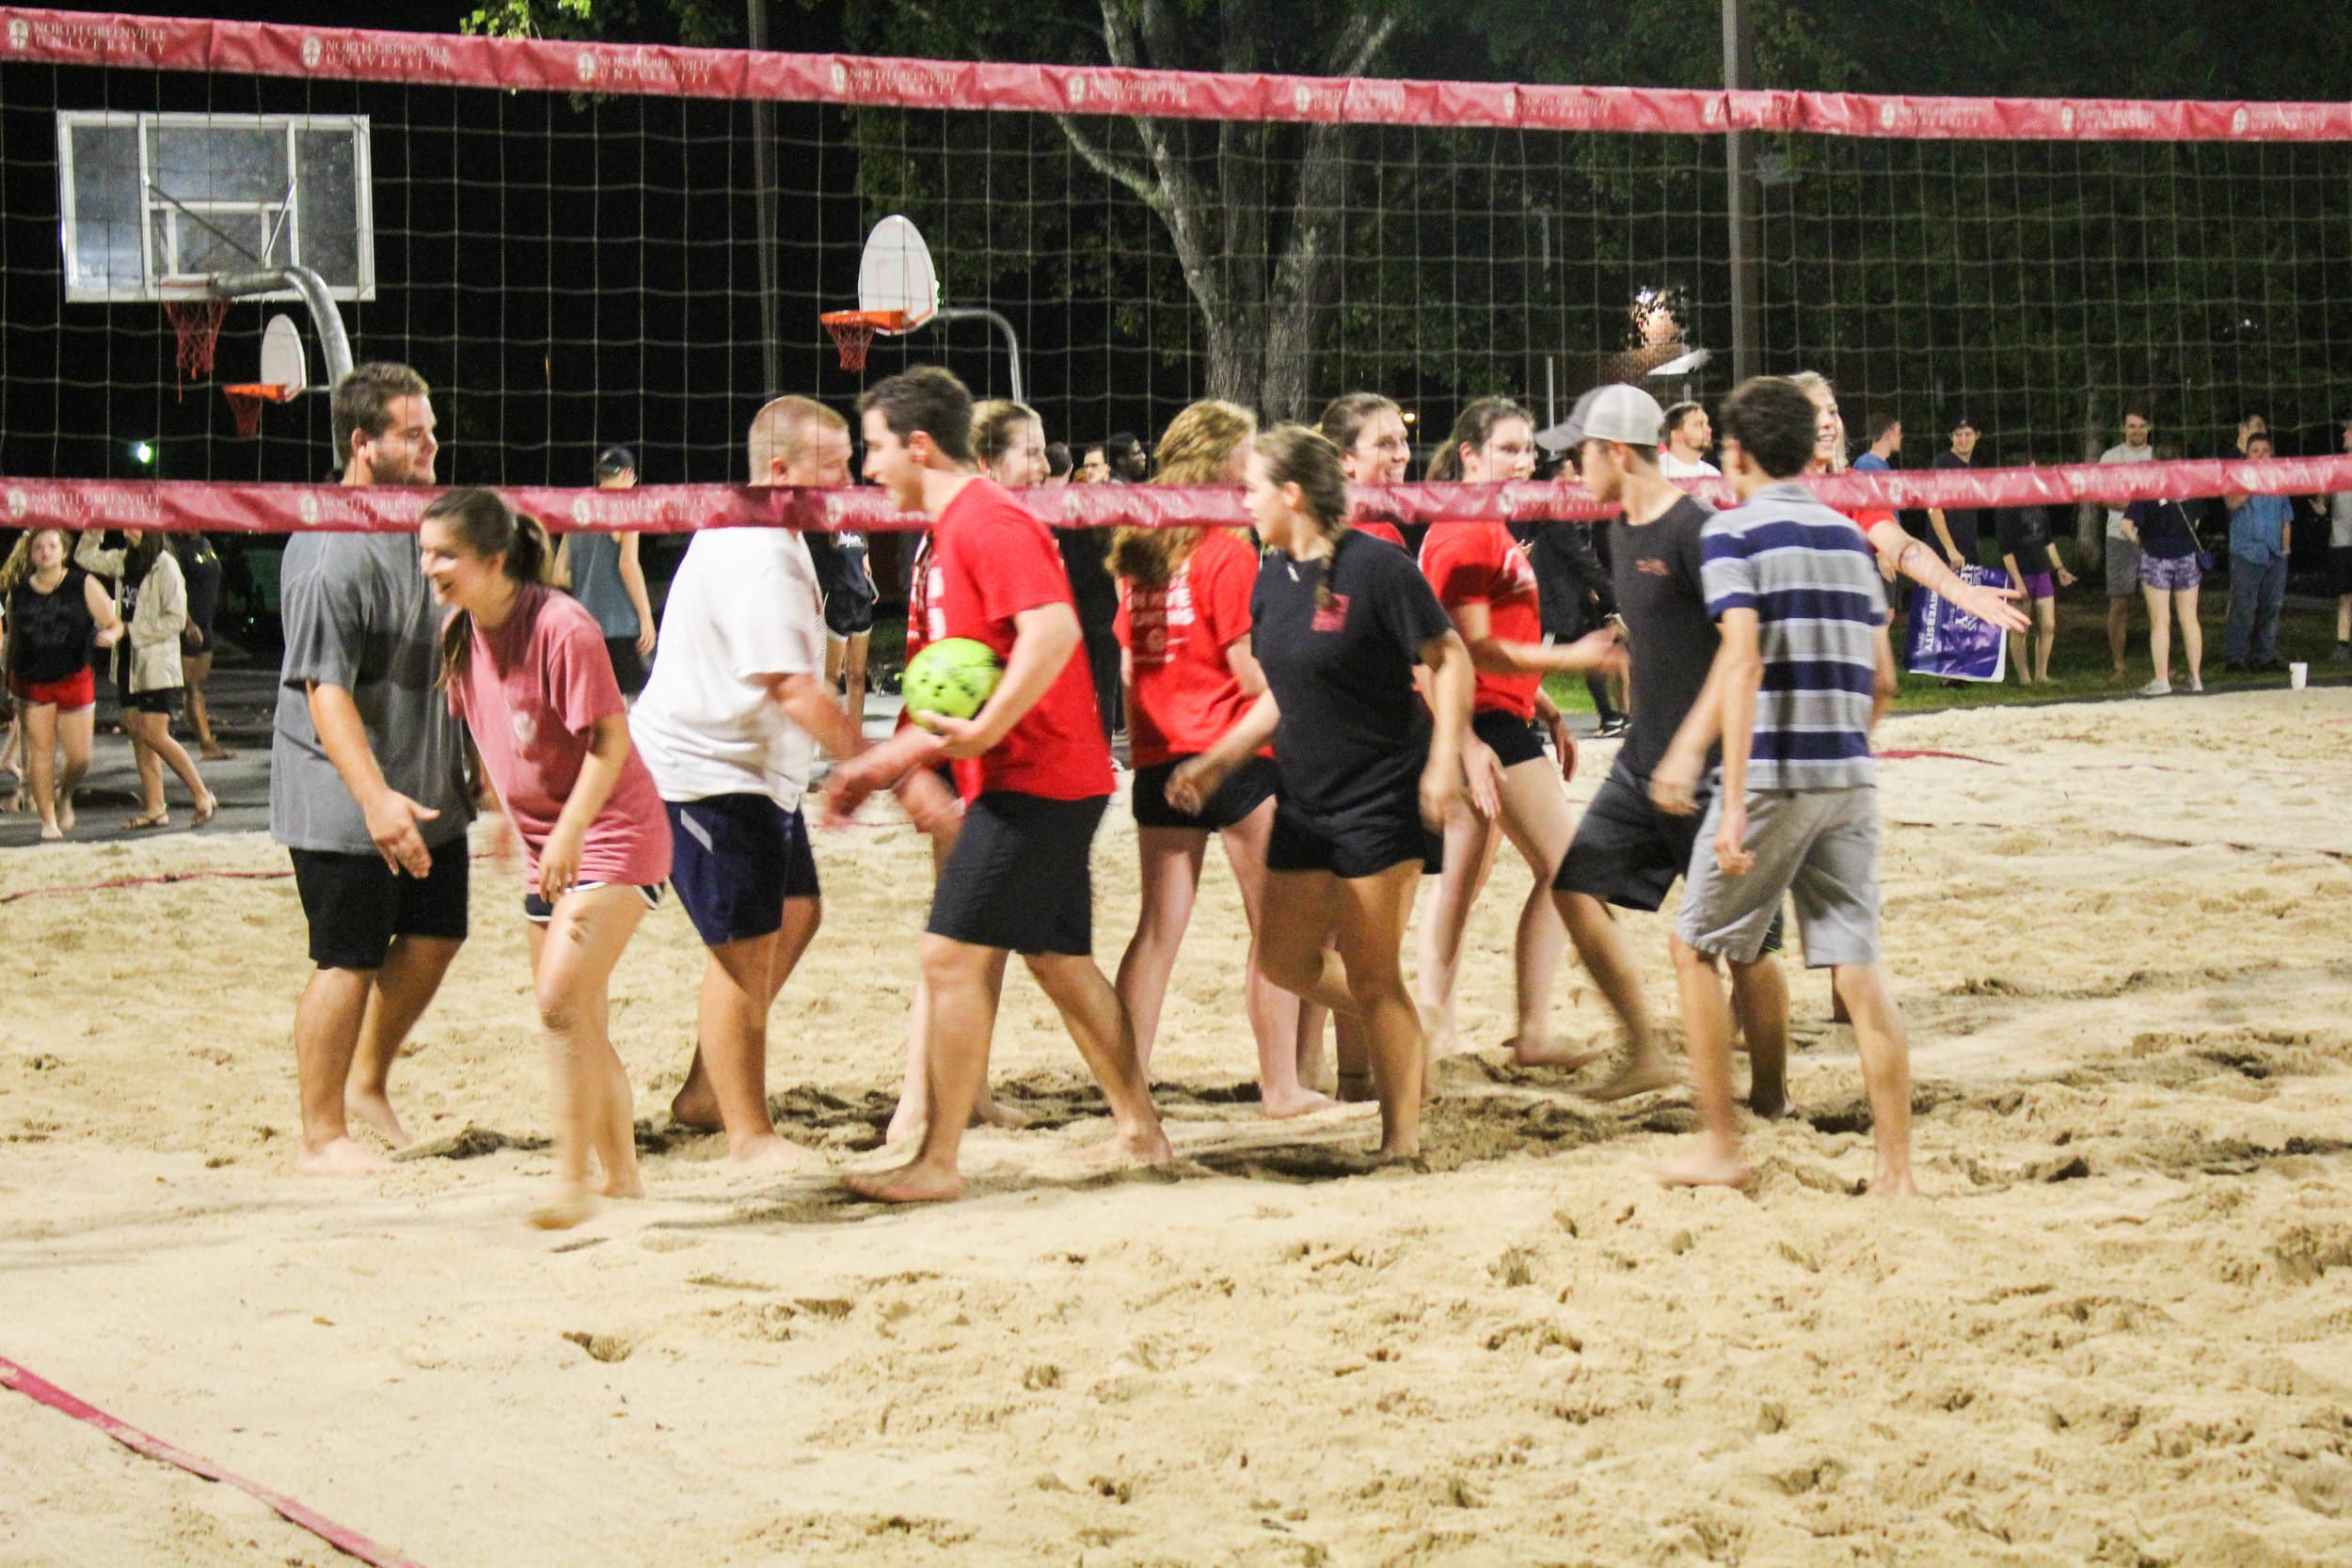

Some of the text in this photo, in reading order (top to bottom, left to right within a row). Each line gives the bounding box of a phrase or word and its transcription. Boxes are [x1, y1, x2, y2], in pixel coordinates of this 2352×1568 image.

[34, 22, 166, 41] NORTH GREENVILLE
[35, 35, 167, 55] UNIVERSITY
[325, 40, 373, 55] NORTH
[326, 54, 450, 71] UNIVERSITY
[599, 68, 711, 84] UNIVERSITY
[849, 69, 892, 82] NORTH
[849, 81, 957, 96] UNIVERSITY
[31, 492, 161, 506] NORTH GREENVILLE
[34, 504, 162, 519] UNIVERSITY
[1924, 590, 1938, 653] NIVERSITY
